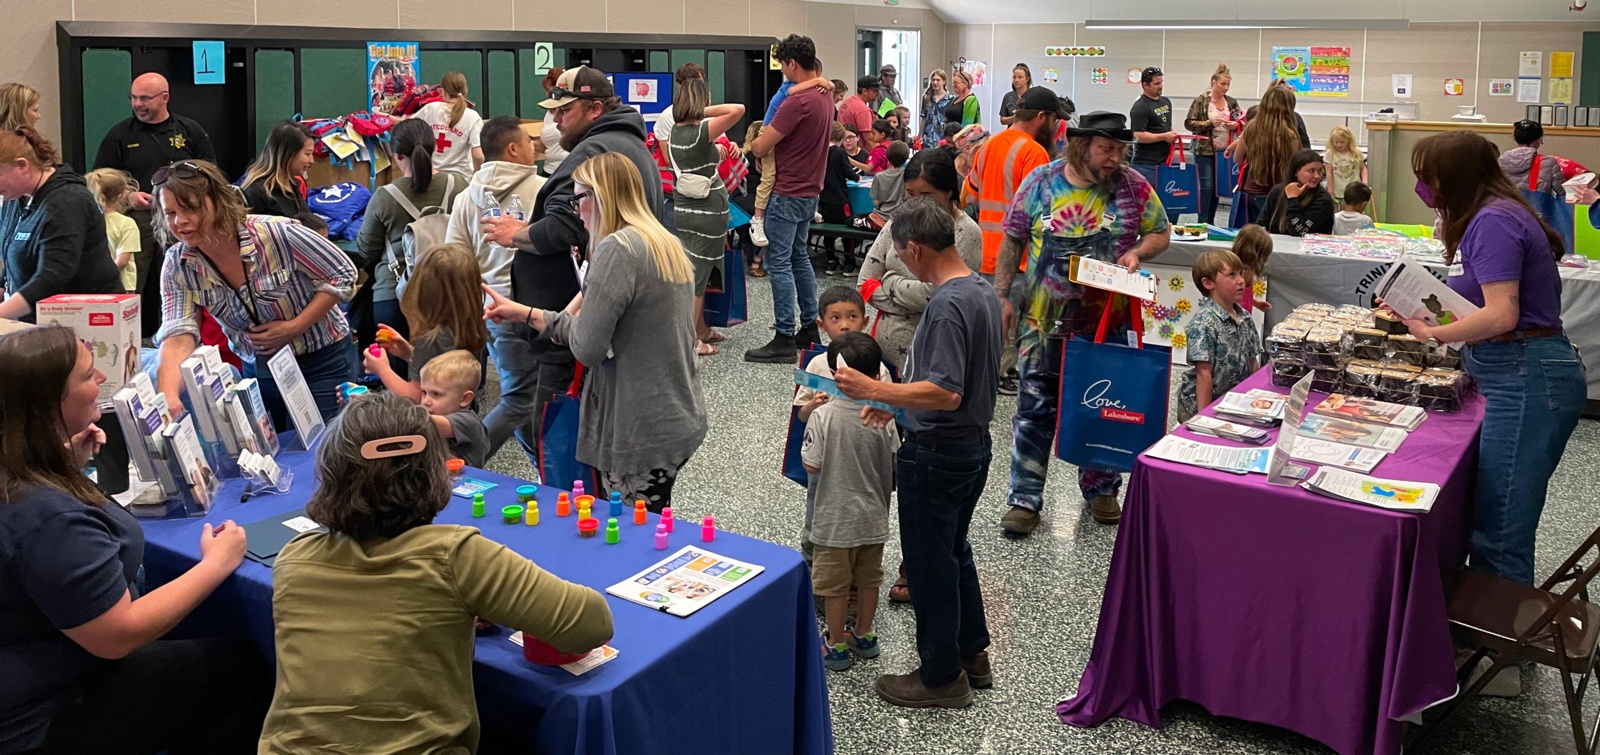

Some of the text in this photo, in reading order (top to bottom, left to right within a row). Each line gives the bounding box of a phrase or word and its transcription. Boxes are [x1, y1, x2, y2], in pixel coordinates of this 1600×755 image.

[197, 49, 215, 74] 1
[369, 44, 385, 58] Get
[537, 45, 551, 70] 2
[1355, 262, 1394, 295] TRINIT
[1104, 410, 1142, 422] Lakeshore
